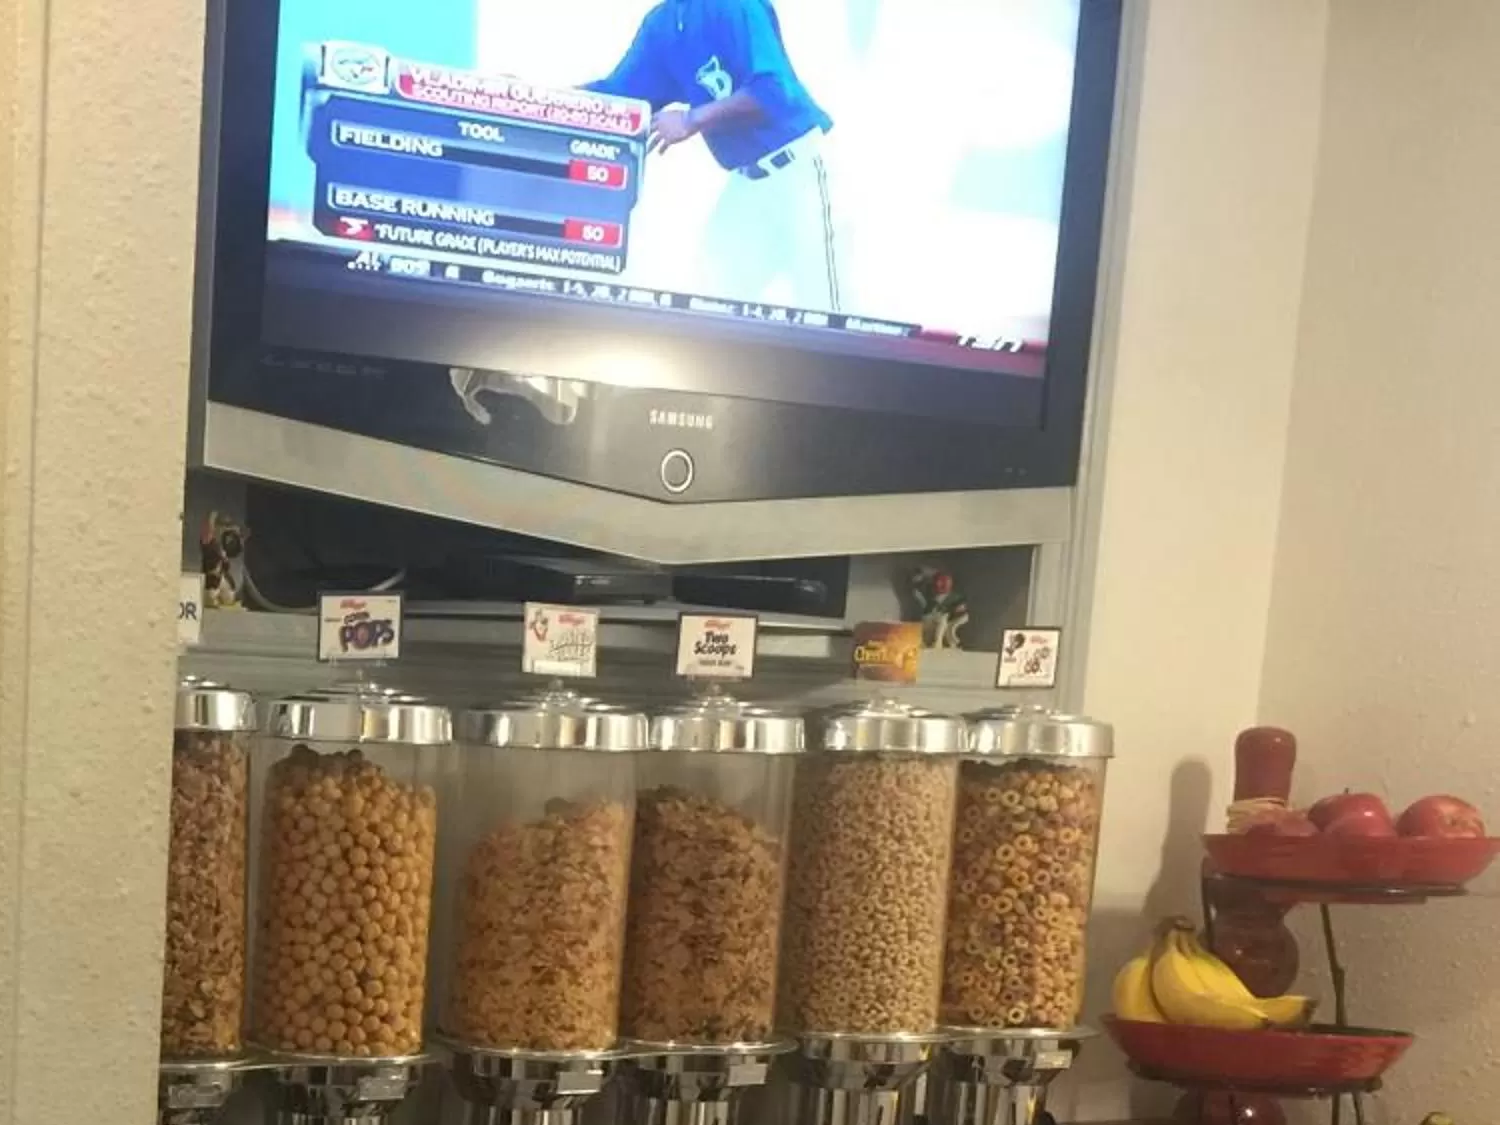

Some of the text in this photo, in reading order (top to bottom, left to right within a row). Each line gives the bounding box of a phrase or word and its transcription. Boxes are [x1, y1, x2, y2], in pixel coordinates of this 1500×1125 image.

[339, 124, 443, 157] FIELDING
[457, 121, 505, 142] TOOL
[335, 188, 494, 227] BASE RUNNING
[648, 409, 713, 430] SAMSUNG
[339, 618, 394, 653] POPS
